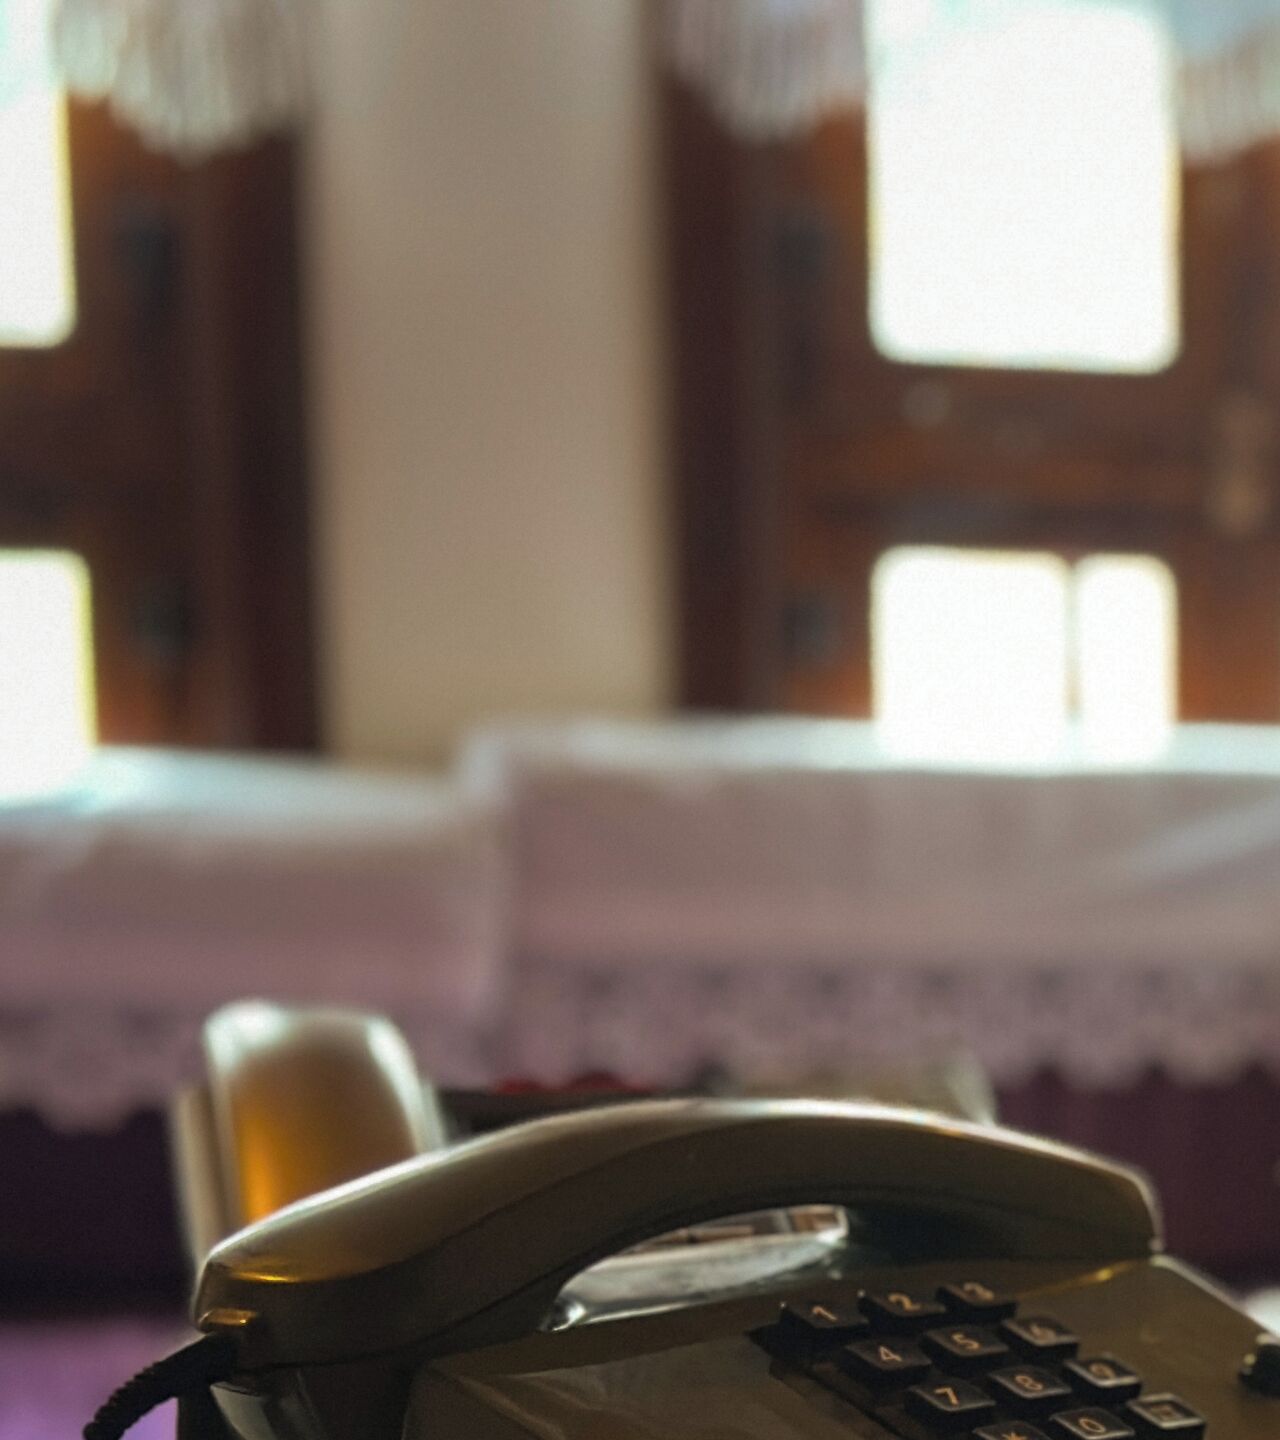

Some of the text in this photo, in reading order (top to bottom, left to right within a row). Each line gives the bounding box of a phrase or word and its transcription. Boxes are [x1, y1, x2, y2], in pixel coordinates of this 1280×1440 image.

[811, 1282, 995, 1321] 1 2 3
[878, 1345, 902, 1361] 4
[952, 1332, 980, 1350] 5
[934, 1386, 960, 1405] 7
[1013, 1374, 1044, 1391] 8
